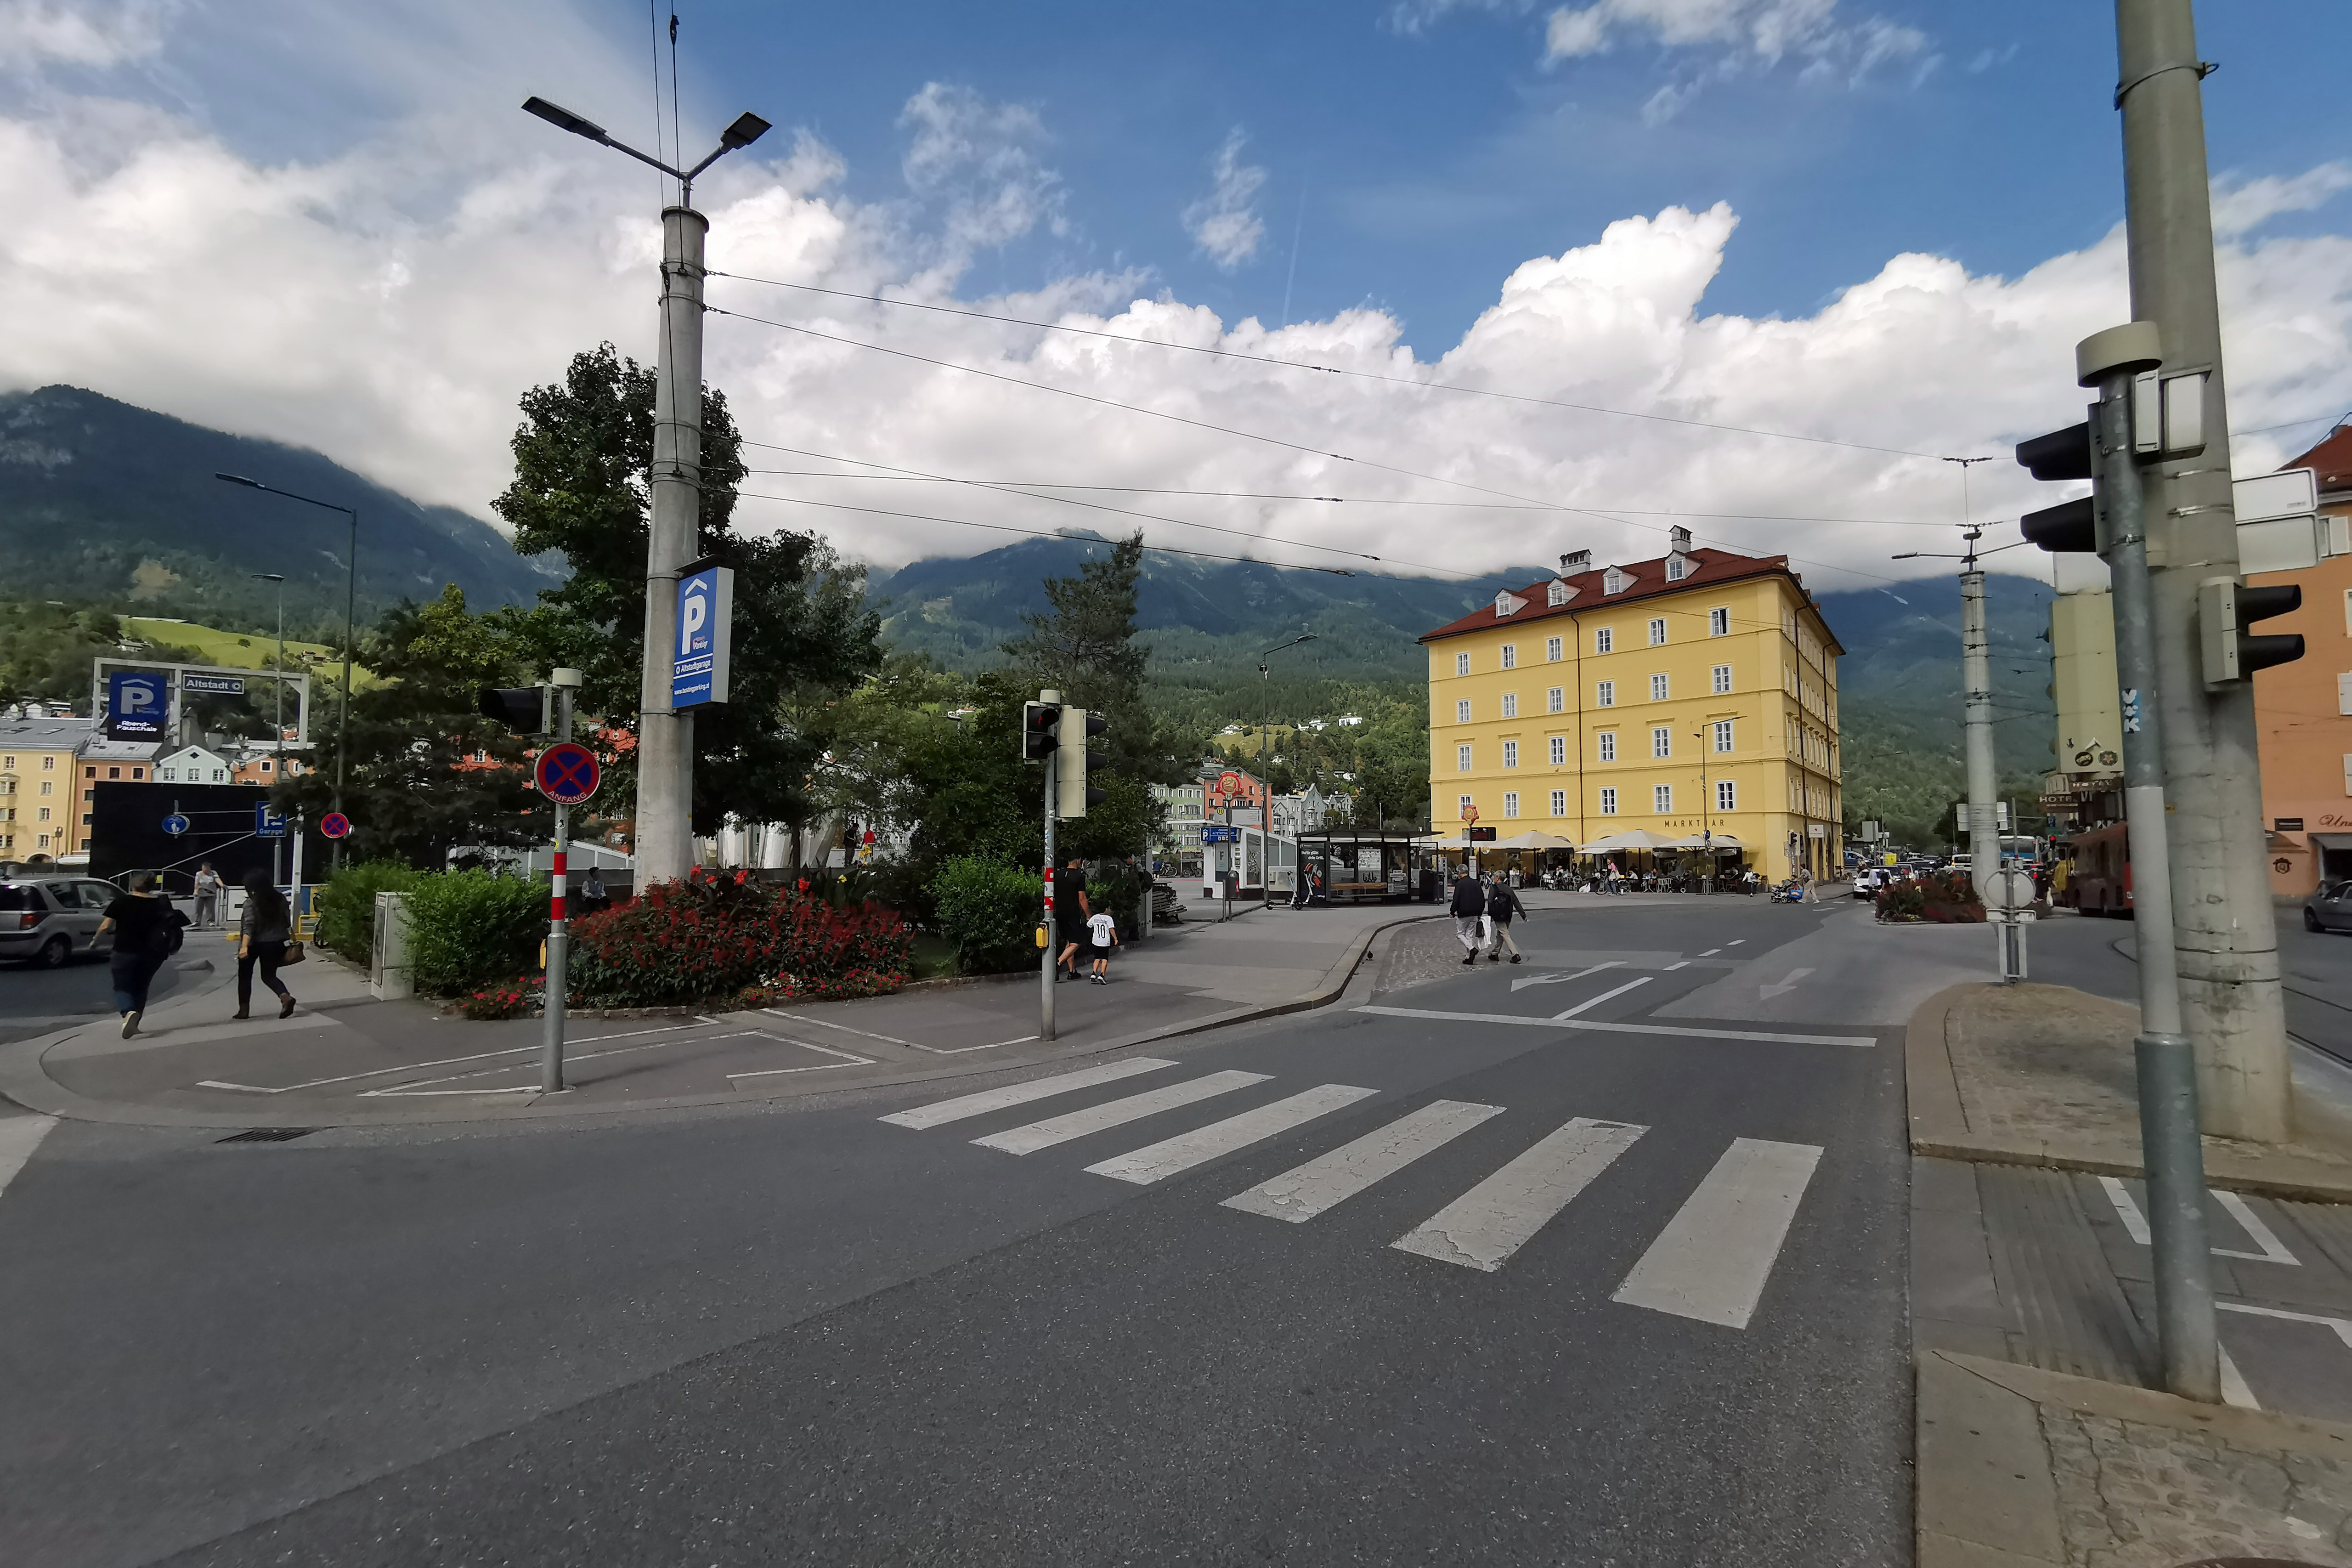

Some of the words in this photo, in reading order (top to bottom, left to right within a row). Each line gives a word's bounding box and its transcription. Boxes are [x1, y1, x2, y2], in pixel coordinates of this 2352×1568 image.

[682, 595, 706, 655] P
[681, 660, 711, 673] Altstadtgarage
[186, 679, 229, 689] Altstadt
[121, 686, 154, 714] P
[548, 791, 587, 803] ANFANG
[1665, 819, 1724, 827] MARKTAR
[1203, 832, 1208, 840] P
[1097, 924, 1105, 939] 10
